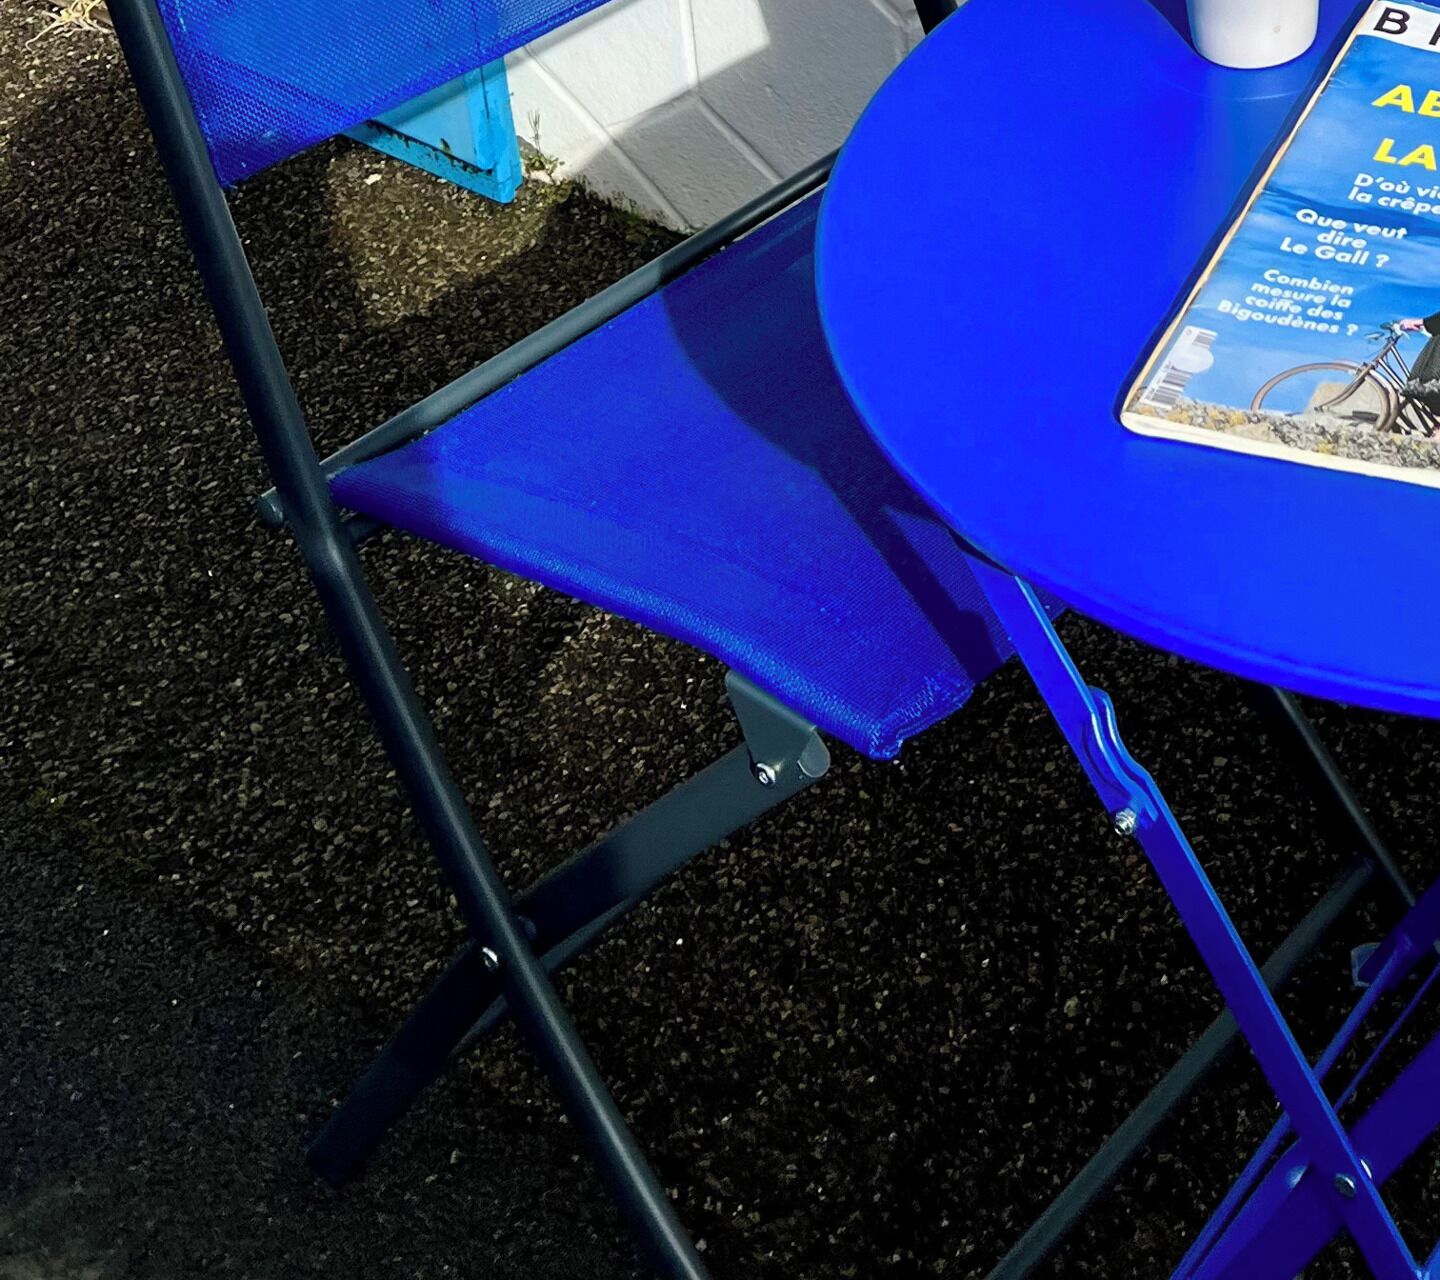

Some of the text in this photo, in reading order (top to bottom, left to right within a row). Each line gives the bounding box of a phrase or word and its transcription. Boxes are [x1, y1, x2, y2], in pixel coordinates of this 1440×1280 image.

[1373, 137, 1437, 171] LA
[1348, 186, 1373, 203] la
[1355, 173, 1410, 194] D'où
[1296, 208, 1407, 239] Que veut
[1280, 237, 1390, 268] Le Gall ?
[1317, 230, 1367, 249] dire
[1264, 269, 1354, 295] Combien
[1245, 295, 1344, 321] coiffe des
[1251, 282, 1352, 309] mesure la
[1217, 299, 1359, 337] Bigoudènes ?
